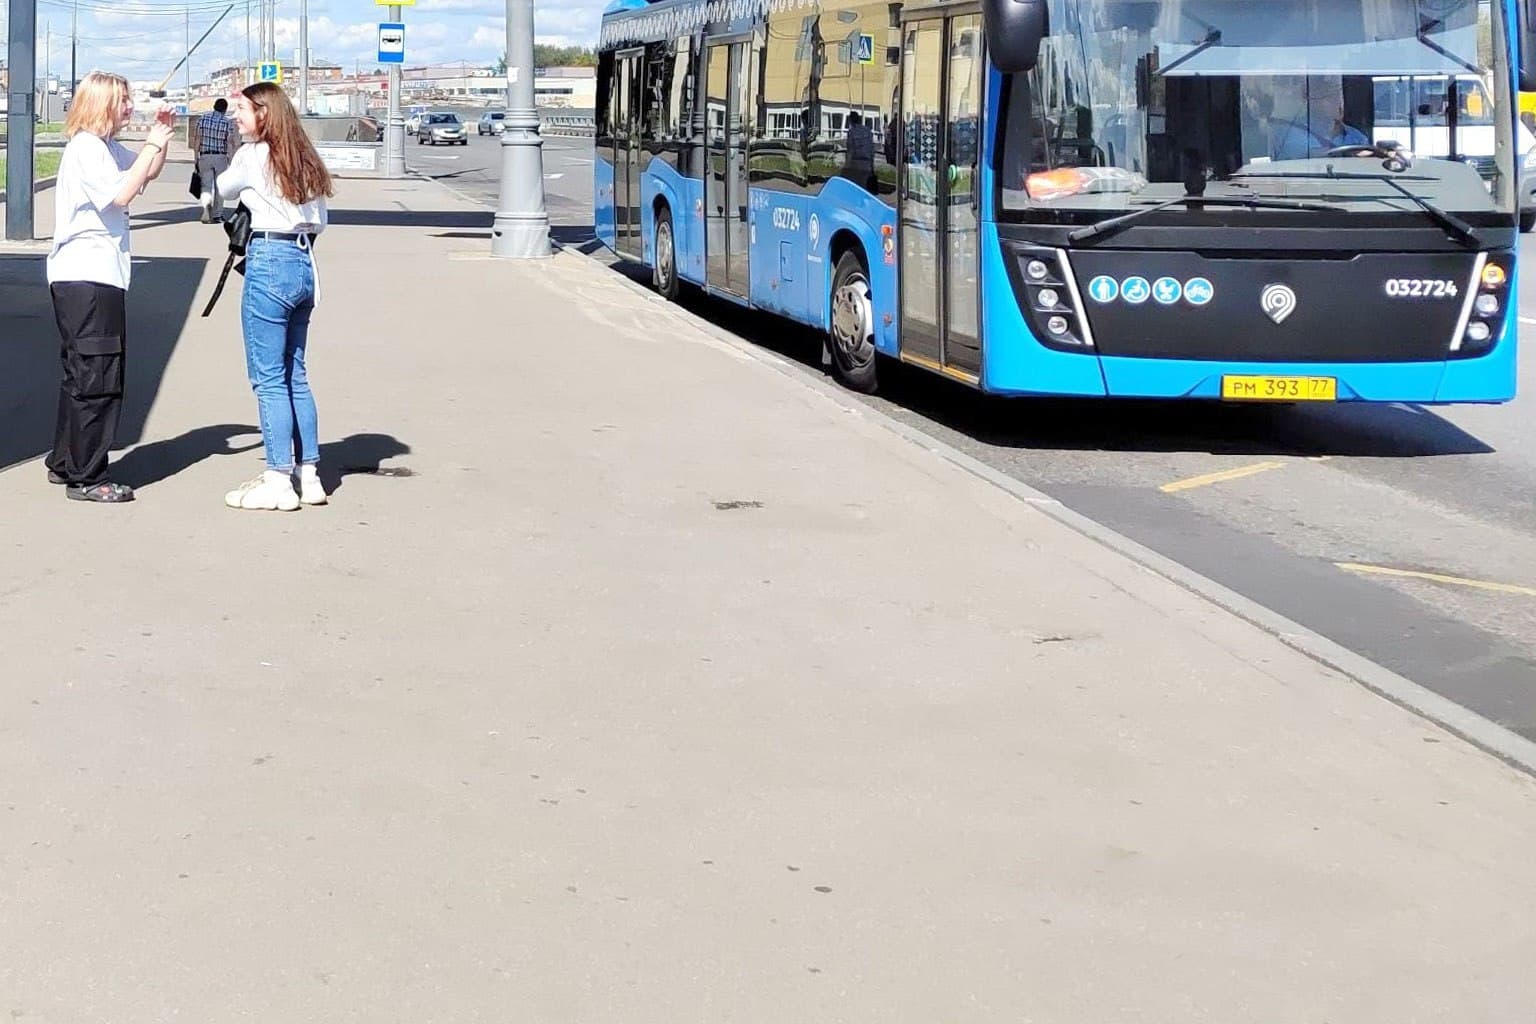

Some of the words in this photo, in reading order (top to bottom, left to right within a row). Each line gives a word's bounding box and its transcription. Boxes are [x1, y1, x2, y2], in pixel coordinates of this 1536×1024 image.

[773, 207, 800, 231] 032724
[1386, 279, 1457, 296] 032724
[1233, 382, 1256, 395] РМ
[1265, 379, 1299, 396] 393
[1311, 379, 1328, 393] 77
